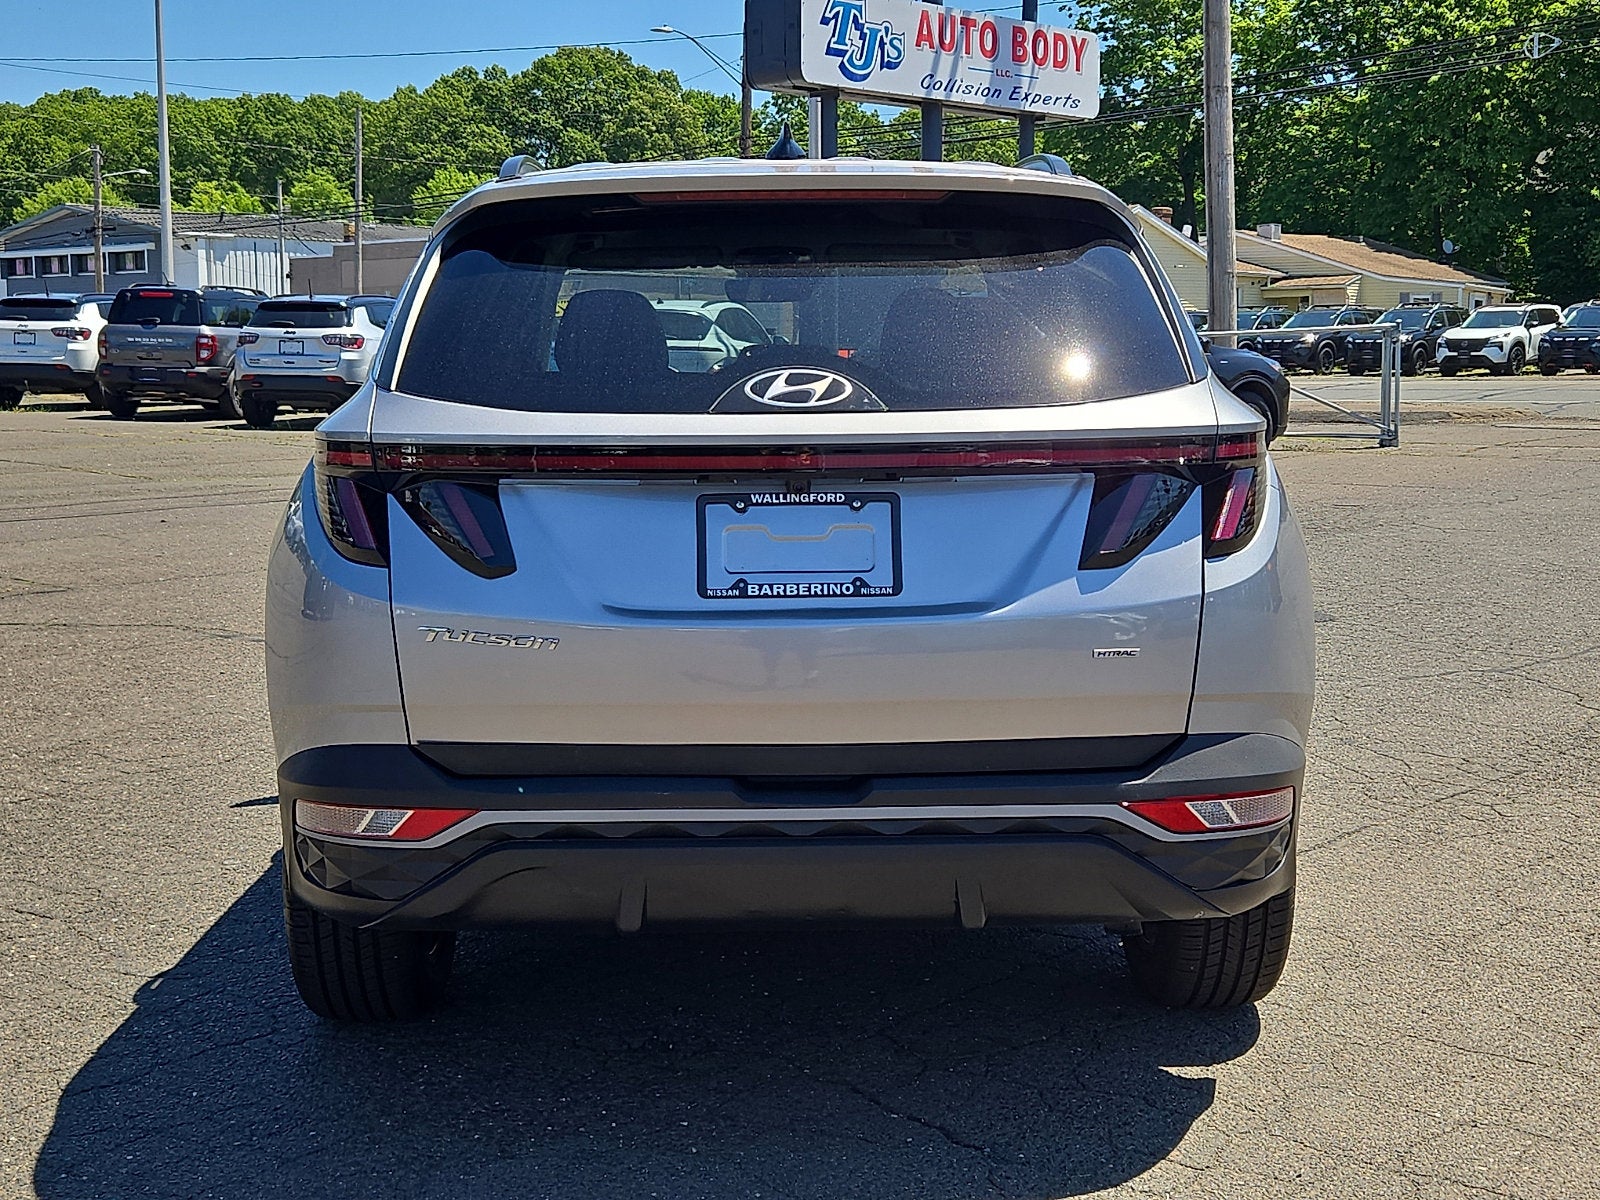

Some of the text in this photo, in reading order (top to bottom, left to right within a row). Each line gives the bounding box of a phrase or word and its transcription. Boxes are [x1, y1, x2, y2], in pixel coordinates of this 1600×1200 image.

[914, 9, 1088, 73] AUTO BODY
[920, 73, 1081, 110] Collision Experts
[750, 493, 846, 504] WALLINGFORD
[707, 583, 893, 597] NISSAN BARBERINO NISSAN
[1096, 649, 1139, 657] HTRAC
